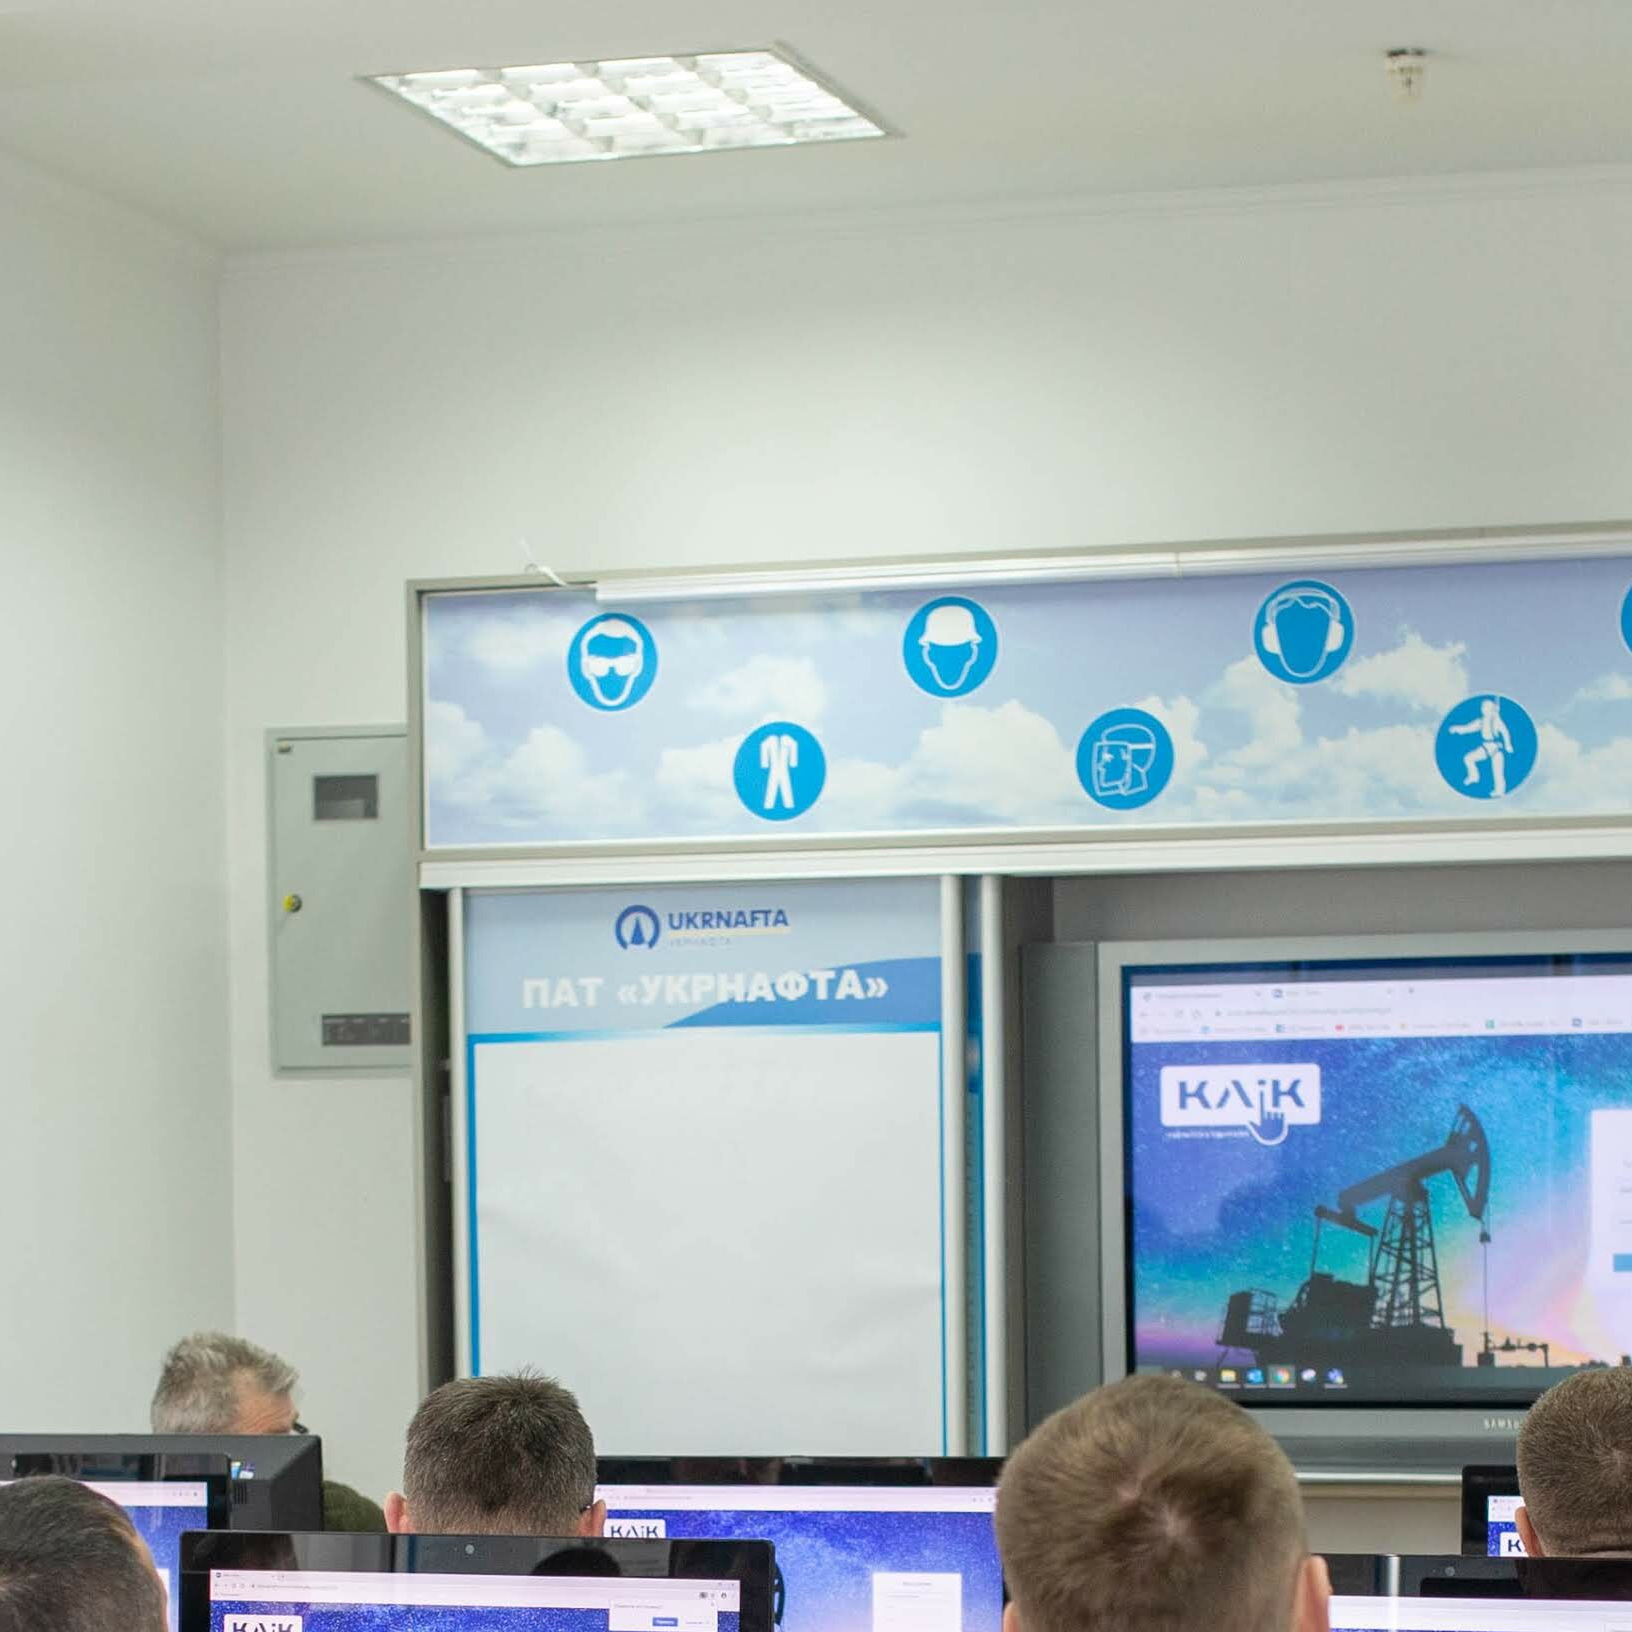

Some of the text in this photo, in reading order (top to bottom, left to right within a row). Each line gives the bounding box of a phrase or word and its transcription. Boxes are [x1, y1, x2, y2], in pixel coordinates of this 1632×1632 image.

[668, 908, 789, 931] UKRNAFTA
[522, 968, 890, 1009] ПАТ «УКРНАФТА»
